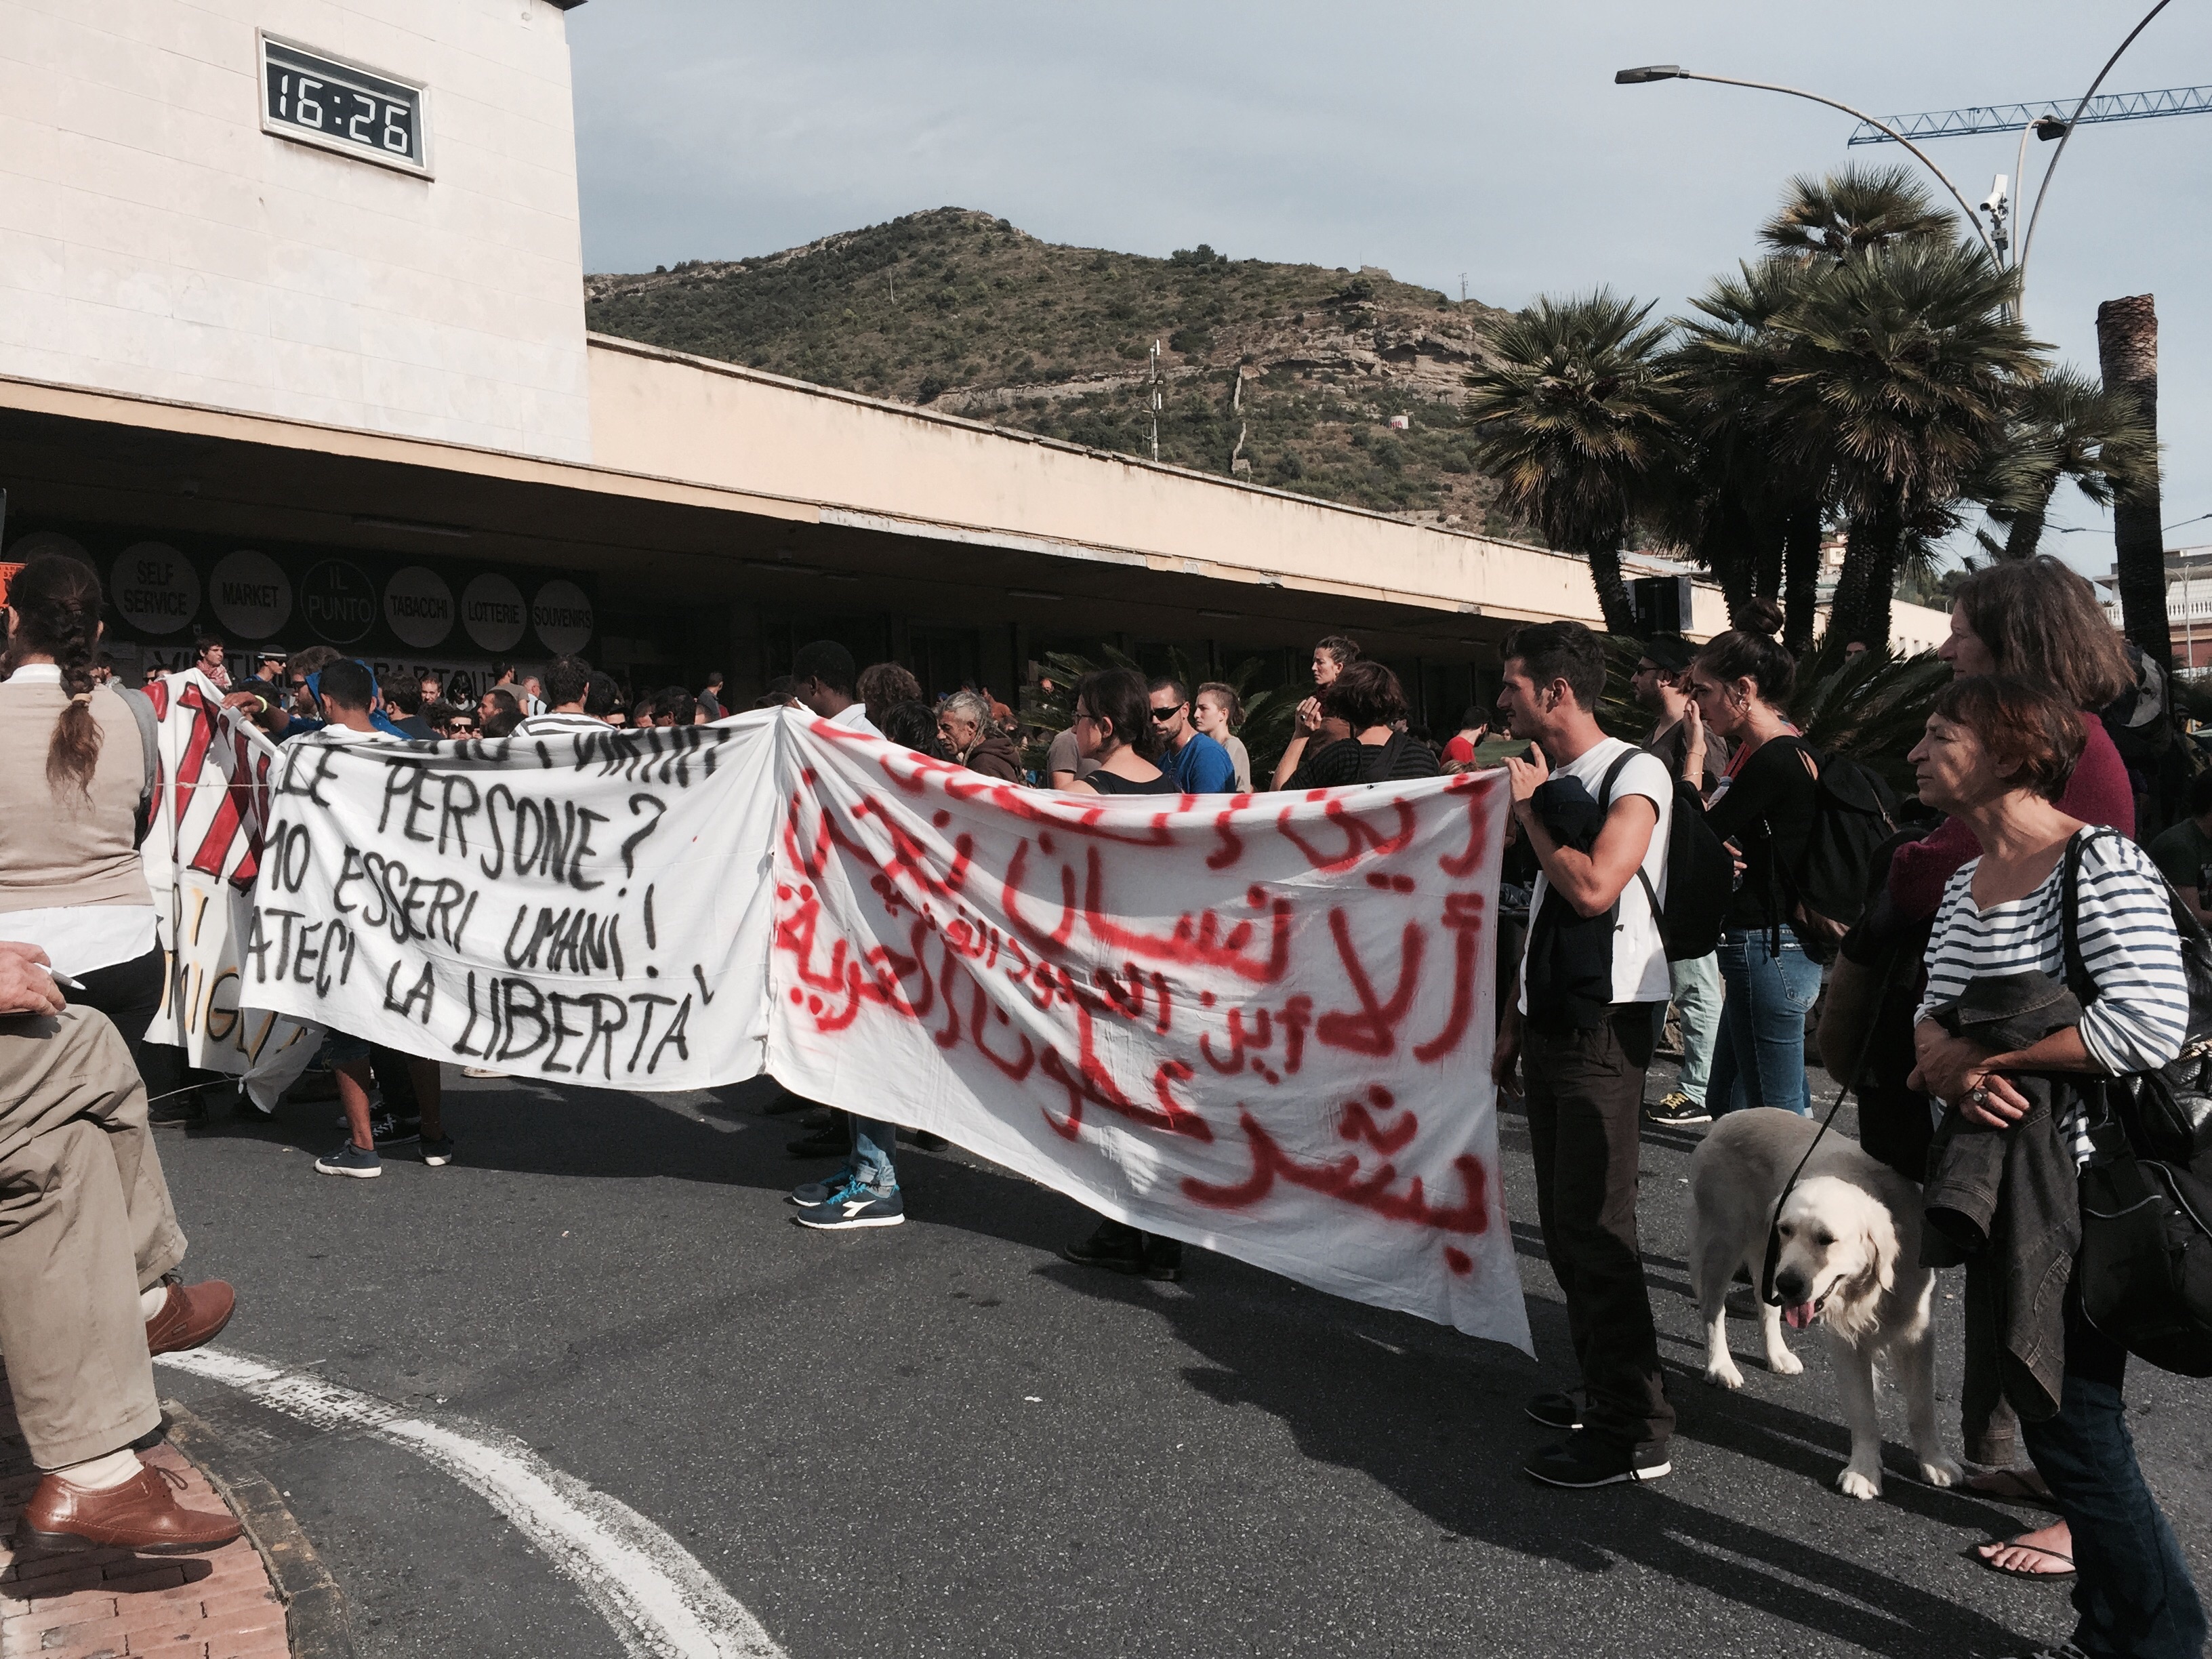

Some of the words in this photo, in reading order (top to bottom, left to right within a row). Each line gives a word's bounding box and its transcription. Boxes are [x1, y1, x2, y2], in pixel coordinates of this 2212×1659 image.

[279, 74, 408, 154] 16:26
[136, 559, 174, 587] SELF
[329, 565, 349, 591] IL
[123, 588, 188, 616] SERVICE
[222, 581, 279, 609] MARKET
[308, 594, 372, 623] PUNTO
[389, 594, 448, 620] TABACCHI
[467, 600, 520, 626] LOTTERIE
[533, 605, 592, 630] SOUVENIRS
[333, 846, 478, 954] ESSERI
[383, 959, 436, 1025] LA
